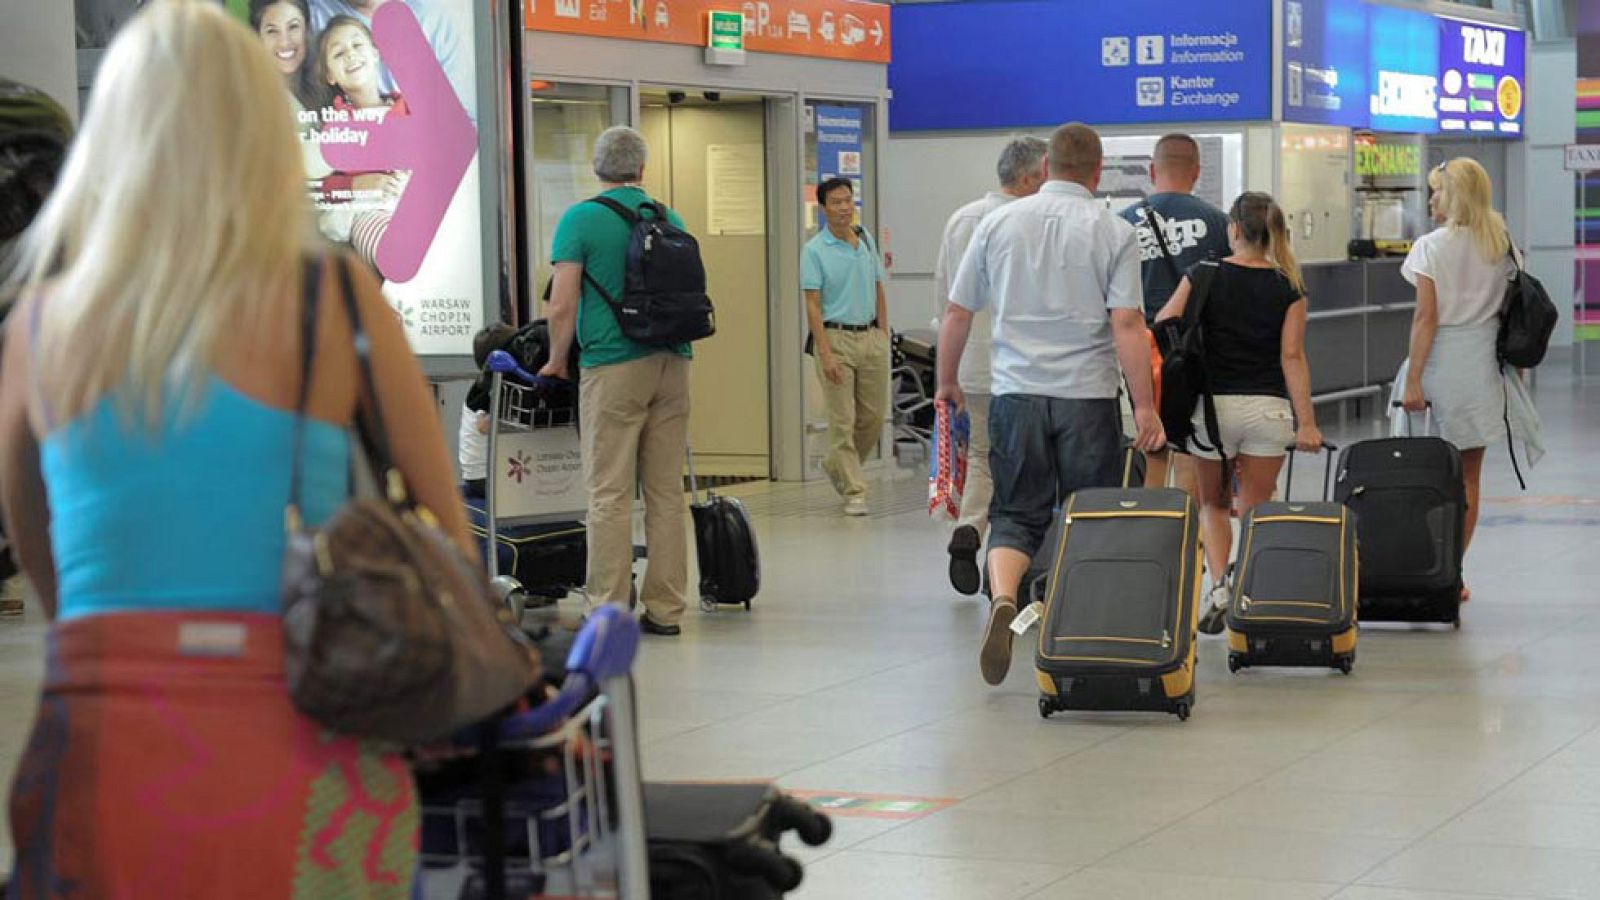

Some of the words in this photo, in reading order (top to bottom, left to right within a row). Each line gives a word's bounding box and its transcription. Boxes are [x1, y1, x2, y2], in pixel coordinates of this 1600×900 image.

[1170, 32, 1238, 47] Informacja
[1461, 26, 1506, 67] TAXI
[1171, 51, 1244, 63] Information
[1170, 75, 1215, 89] Kantor
[1171, 92, 1240, 106] Exchange
[297, 110, 318, 122] on
[321, 106, 349, 122] the
[352, 109, 385, 125] way
[310, 128, 368, 146] holiday
[421, 299, 471, 309] WARSAW
[421, 311, 471, 322] CHOPIN
[421, 324, 471, 336] AIRPORT
